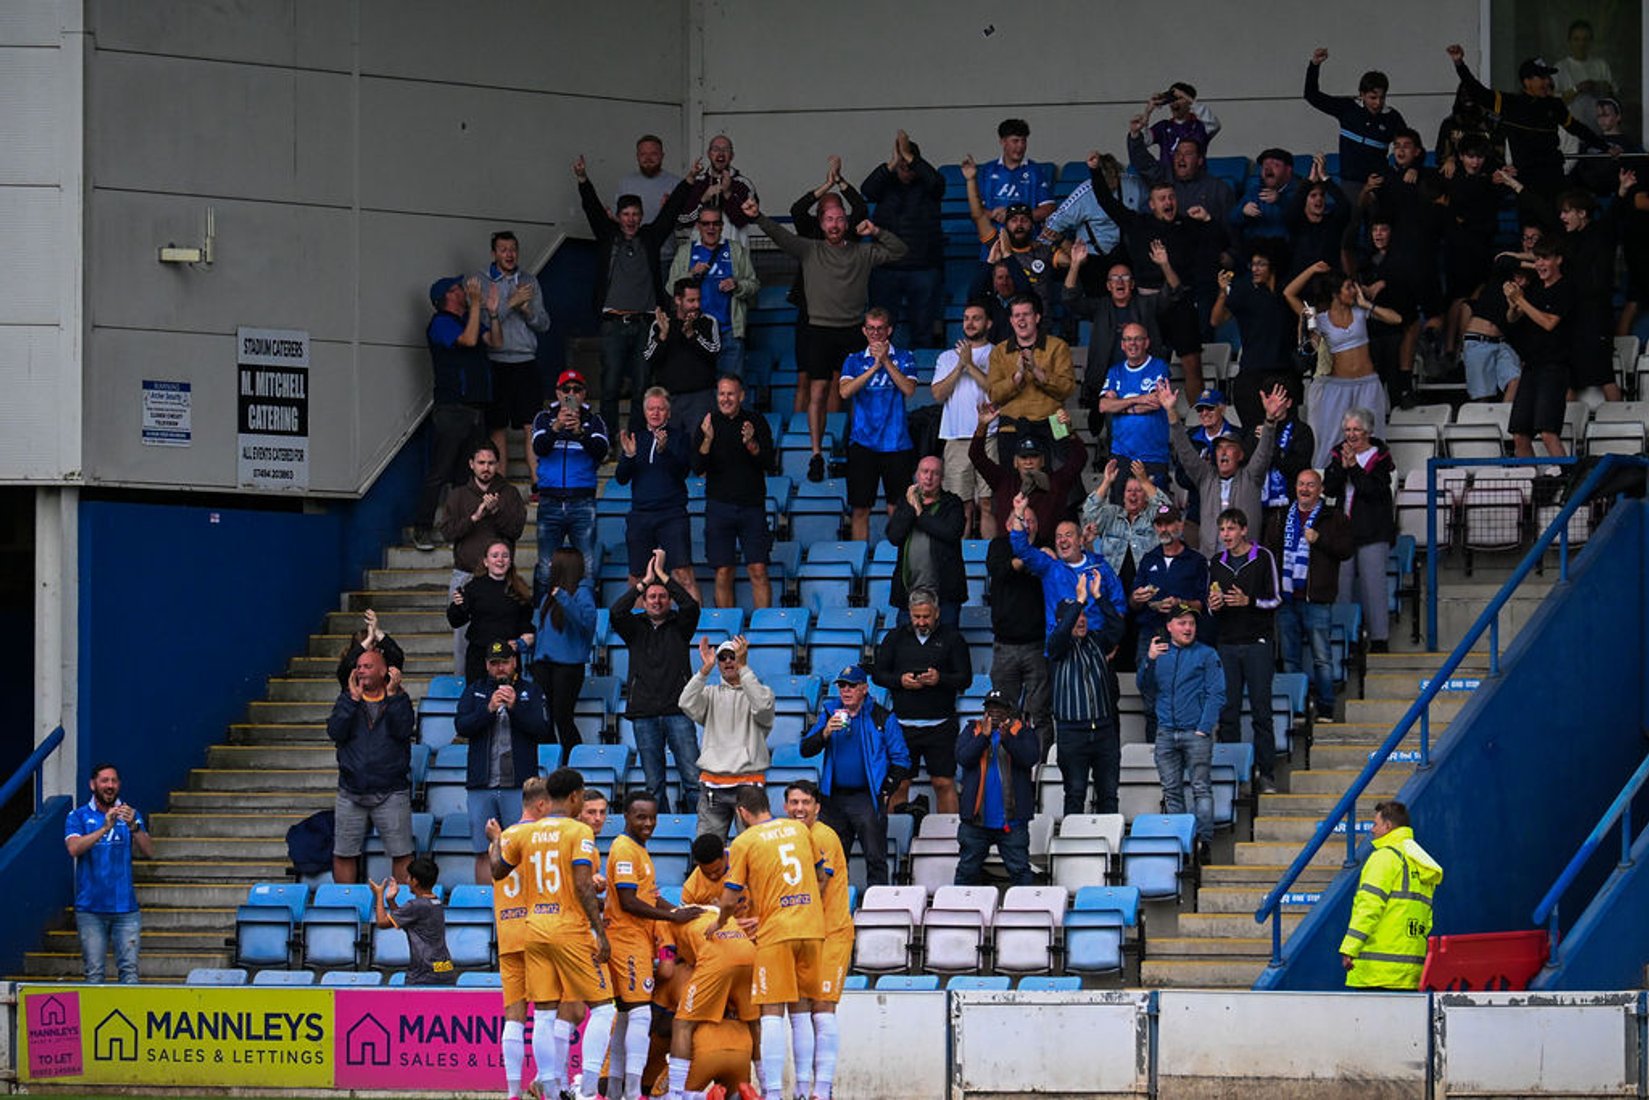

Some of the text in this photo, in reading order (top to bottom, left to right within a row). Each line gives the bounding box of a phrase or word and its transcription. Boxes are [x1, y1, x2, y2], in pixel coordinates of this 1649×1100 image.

[244, 338, 303, 358] STADIUM CATERERS
[255, 371, 305, 399] MITCHELL
[248, 404, 299, 432] CATERING
[253, 446, 272, 461] EVENTS
[273, 447, 294, 462] CATERED
[295, 448, 304, 462] FOR
[532, 831, 561, 844] EVANS
[760, 826, 798, 841] TAYLOR
[530, 850, 561, 894] 15
[778, 843, 803, 887] 5
[30, 1026, 79, 1038] MANNLEYS
[147, 1011, 324, 1042] MANNLEYS
[39, 1053, 73, 1066] TO LET
[147, 1048, 324, 1065] SALES & LETTINGS
[400, 1052, 459, 1067] SALES
[467, 1053, 478, 1067] &
